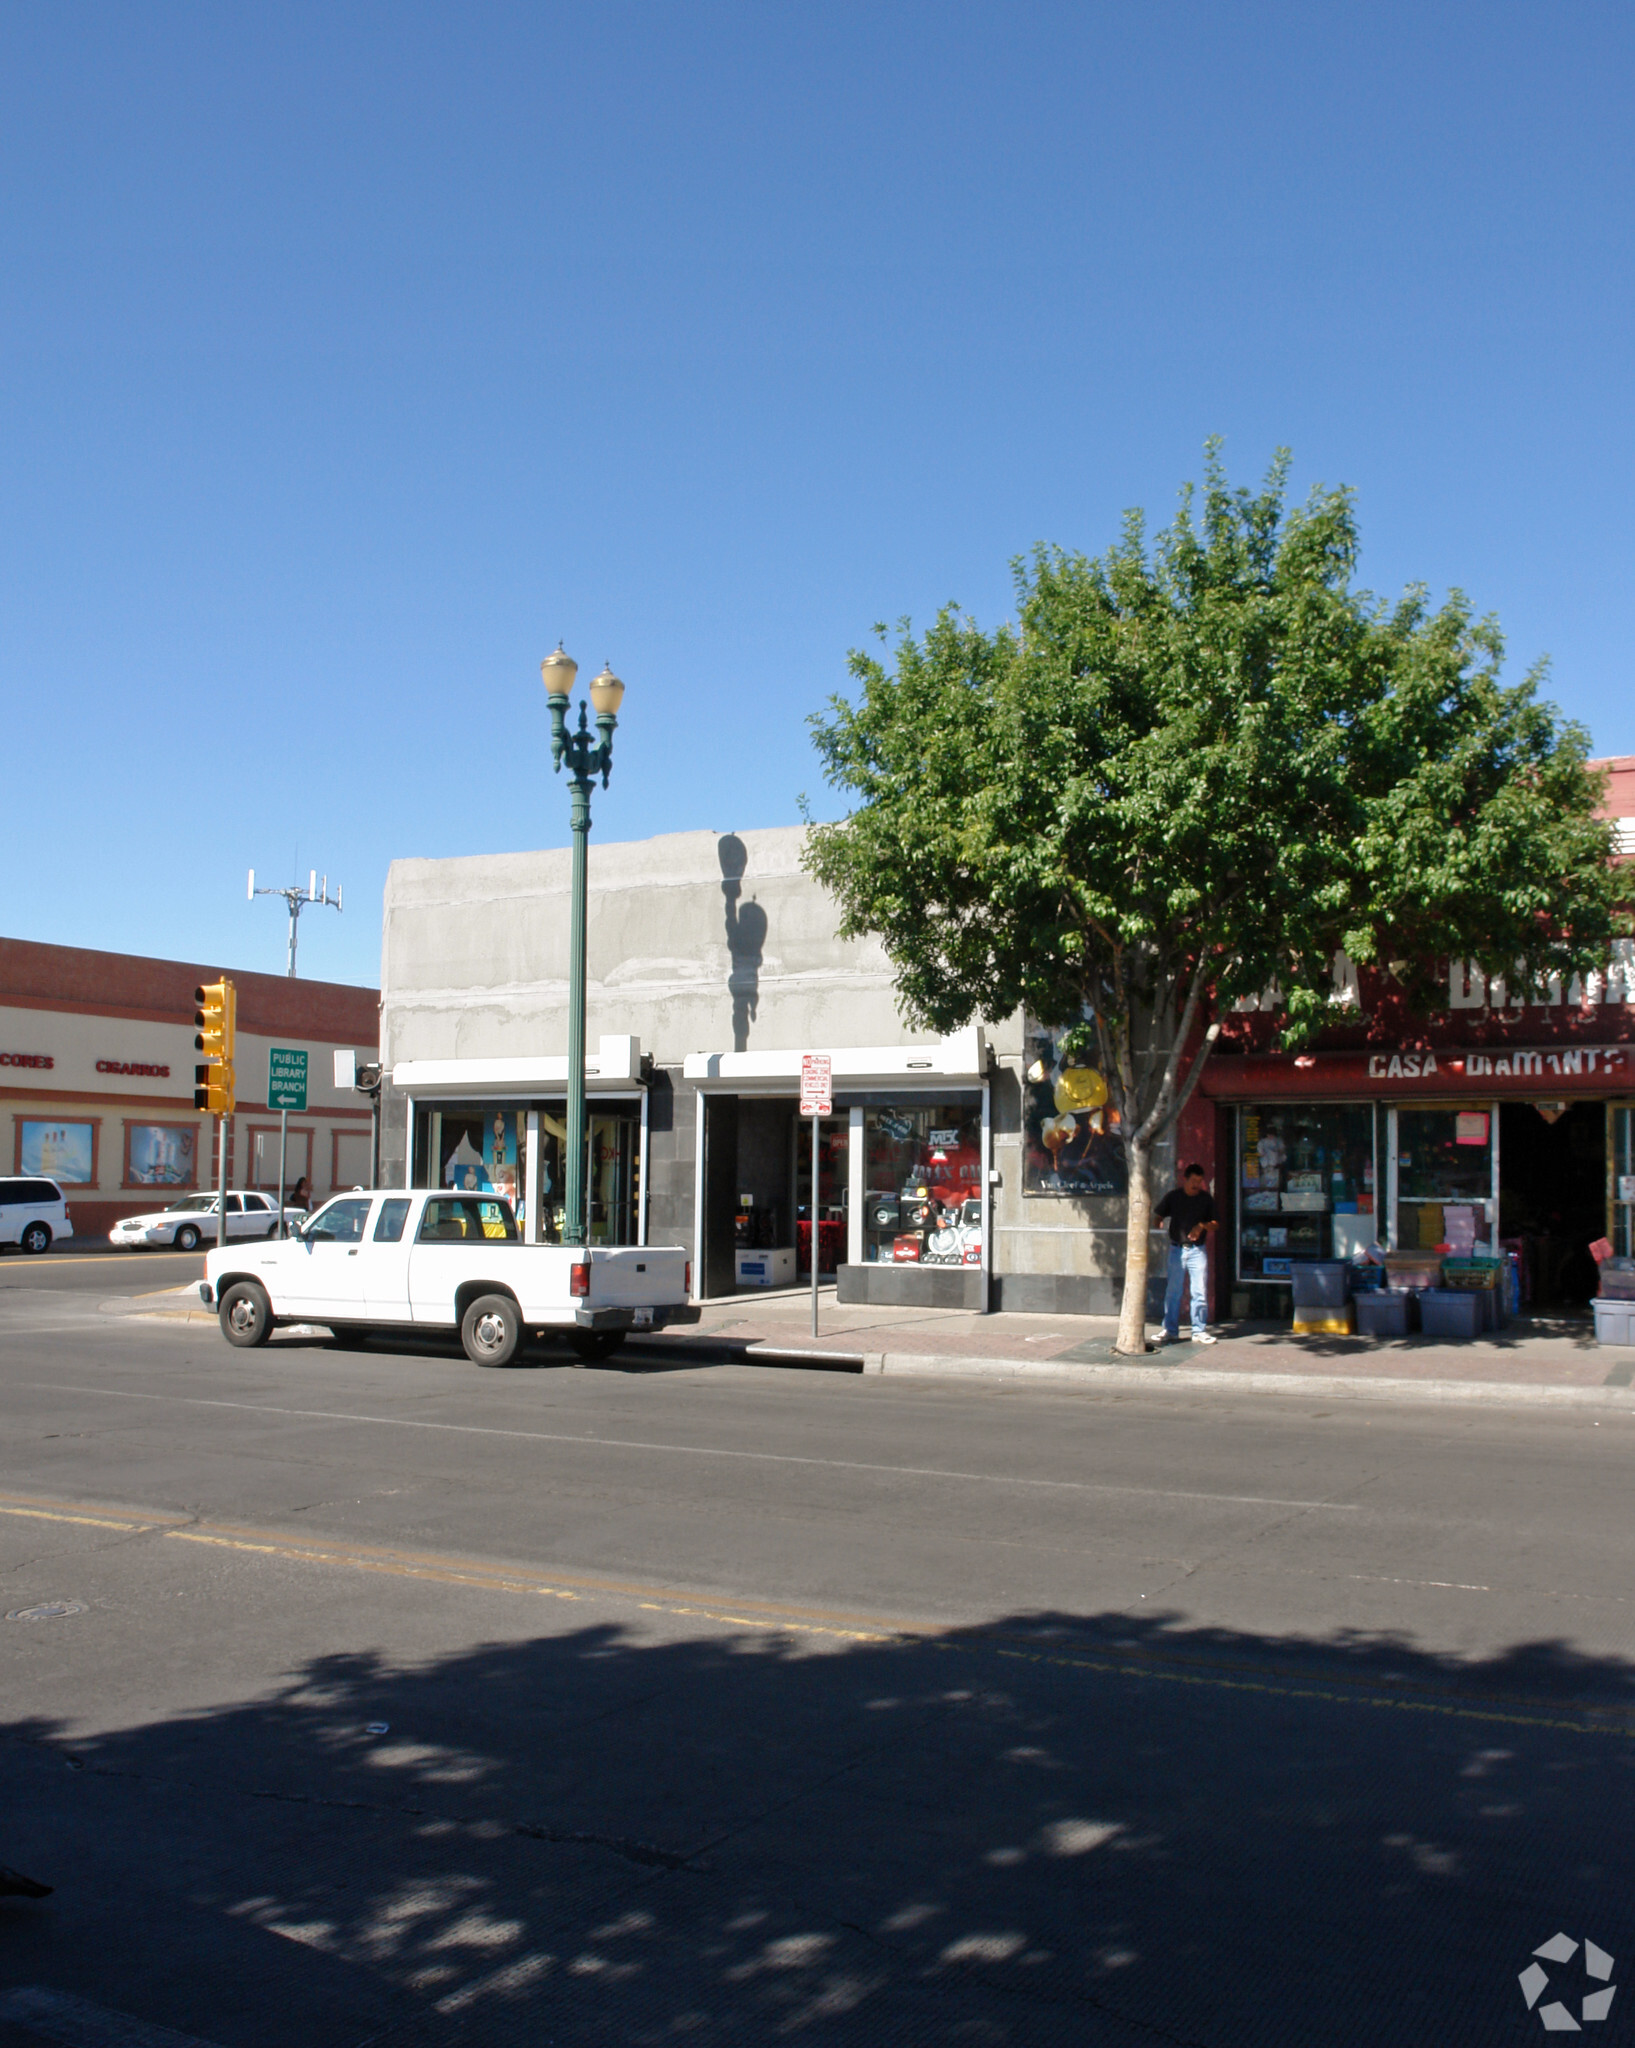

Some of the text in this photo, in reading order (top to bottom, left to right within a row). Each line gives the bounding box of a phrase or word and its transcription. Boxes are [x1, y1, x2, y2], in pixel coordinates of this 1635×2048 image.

[0, 1053, 54, 1069] CORES
[273, 1053, 305, 1065] PUBLIC
[1369, 1054, 1438, 1078] CASA
[96, 1060, 170, 1078] CIGARROS
[271, 1067, 306, 1079] LIBRARY
[271, 1080, 305, 1092] BRANCH
[928, 1129, 959, 1146] MTX
